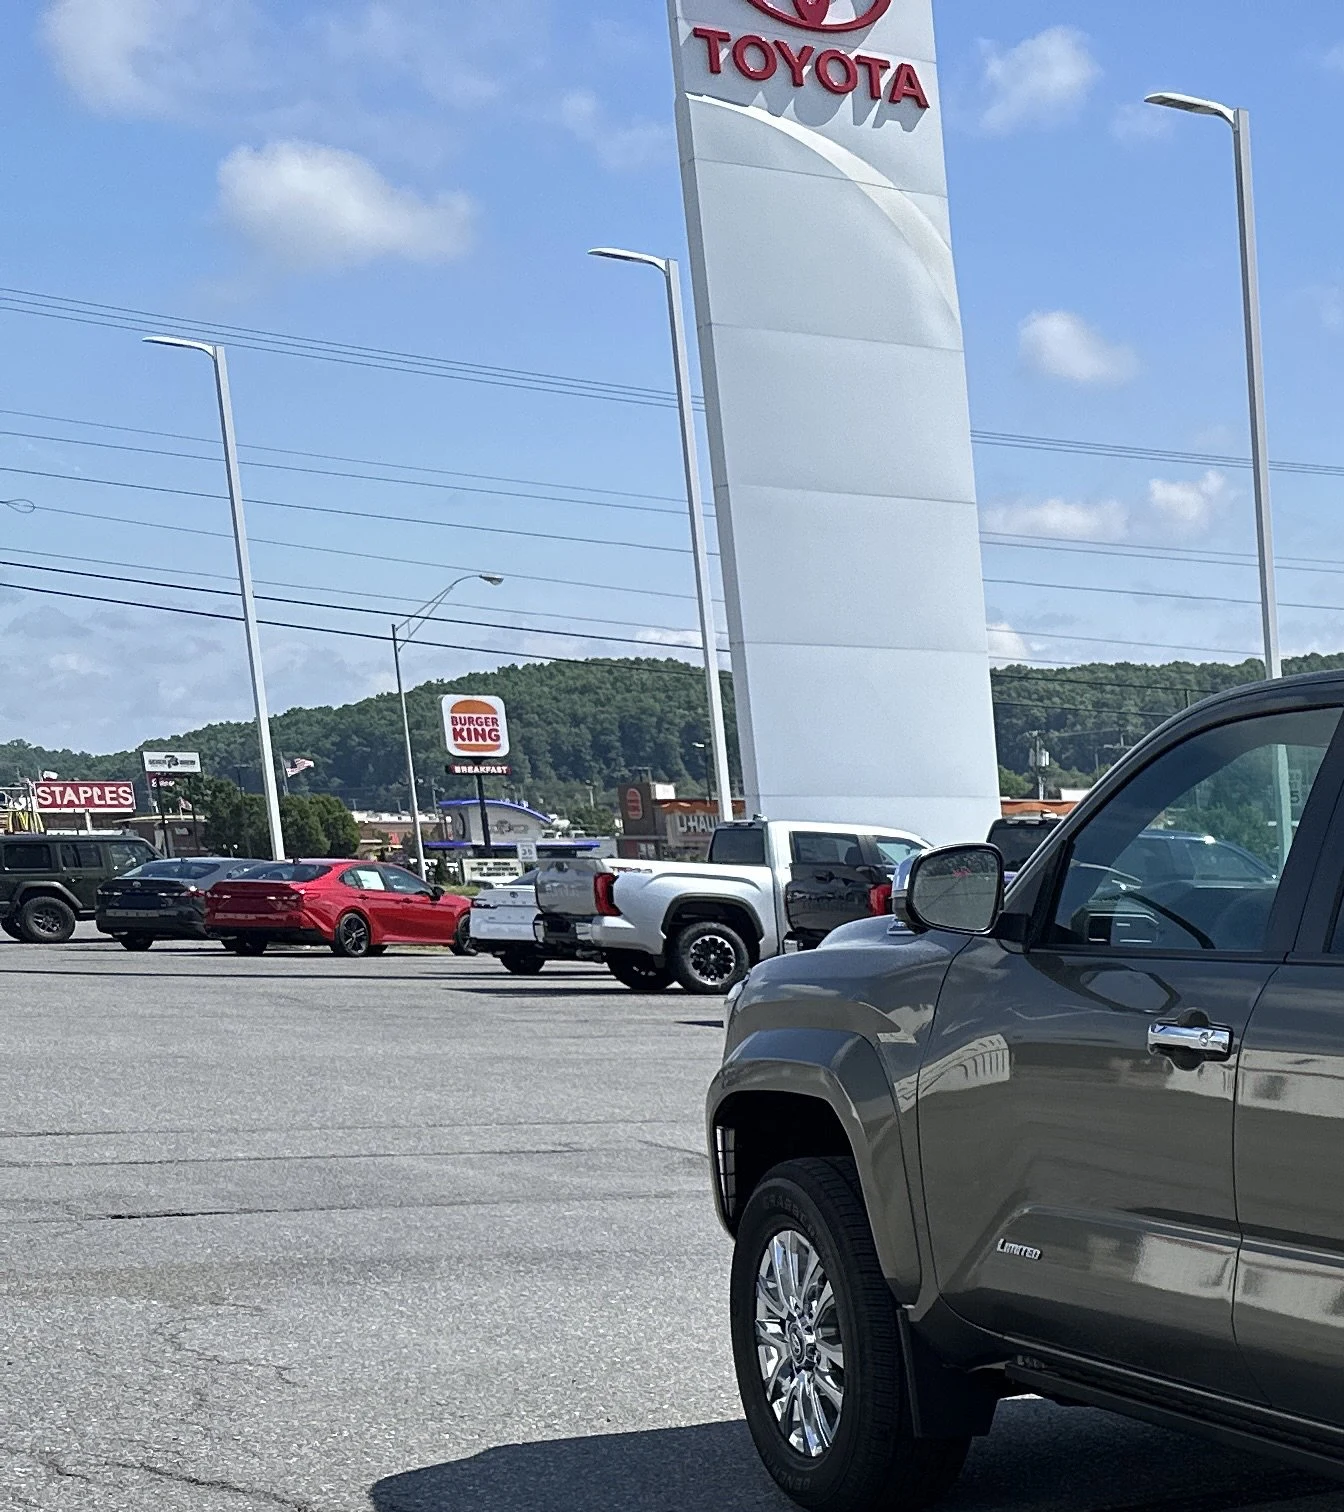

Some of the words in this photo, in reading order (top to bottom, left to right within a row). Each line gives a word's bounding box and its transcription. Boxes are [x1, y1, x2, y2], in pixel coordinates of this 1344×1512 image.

[693, 27, 930, 109] TOYOTA
[450, 716, 500, 727] BURGER
[452, 727, 501, 742] KING
[454, 765, 508, 774] BREAKFAST
[37, 786, 133, 806] STAPLES
